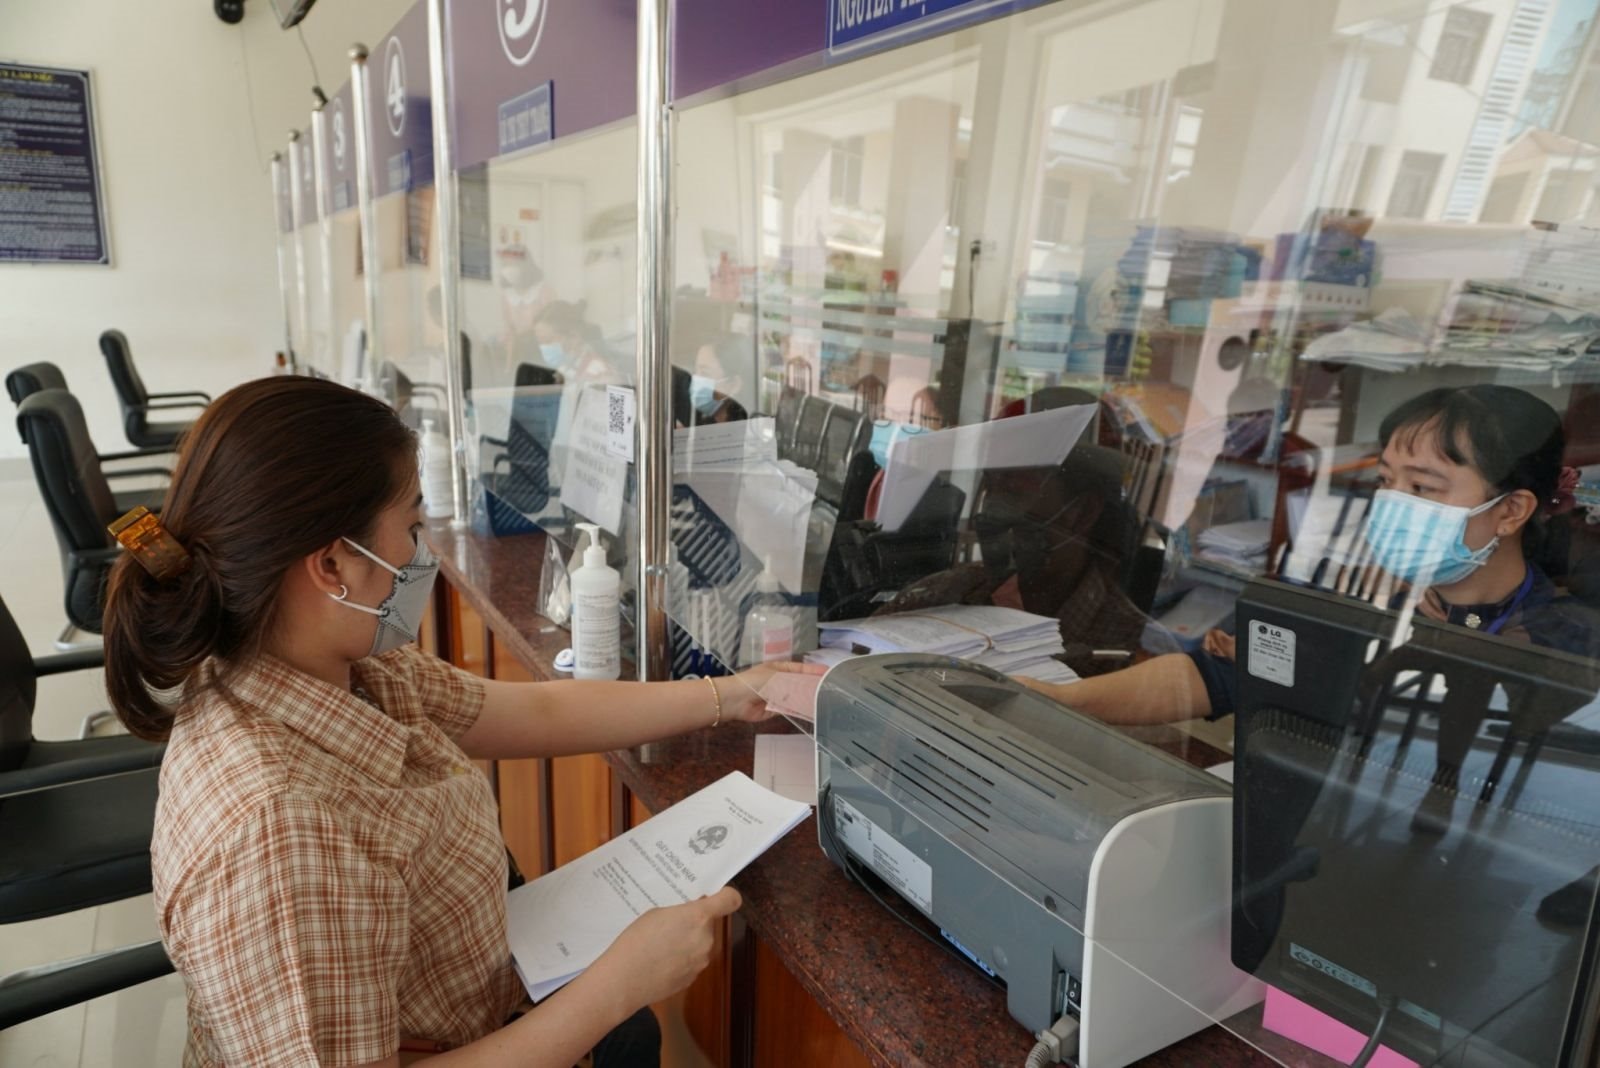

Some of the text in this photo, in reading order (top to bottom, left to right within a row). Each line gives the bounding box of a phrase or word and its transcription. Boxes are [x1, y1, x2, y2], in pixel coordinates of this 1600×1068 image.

[836, 0, 894, 31] NGU
[388, 54, 404, 117] 4
[333, 111, 345, 158] 3
